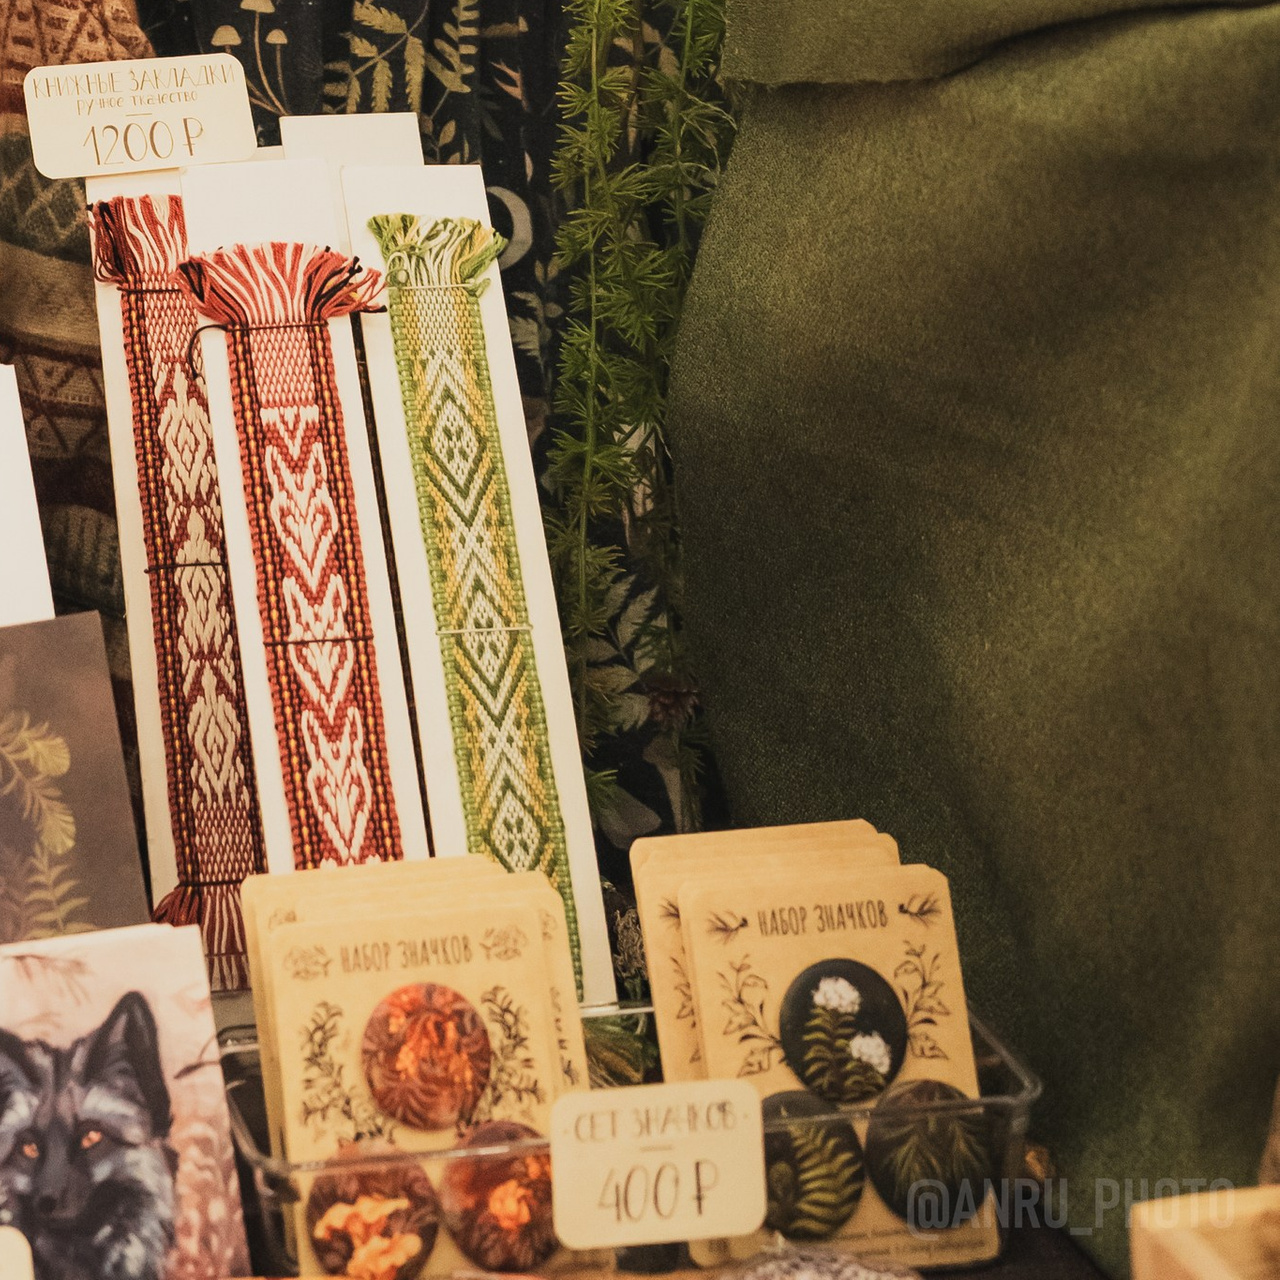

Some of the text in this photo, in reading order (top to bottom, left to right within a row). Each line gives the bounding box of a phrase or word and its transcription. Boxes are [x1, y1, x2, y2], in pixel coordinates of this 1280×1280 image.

[32, 64, 235, 98] КНИЖНЫЕ ЗАКЛАДКИ
[76, 91, 198, 116] ручное ткачество
[82, 120, 174, 165] 1200
[757, 899, 888, 937] НАБОР ЗНАЧКОВ
[340, 934, 473, 973] НАБОР ЗНАЧКОВ
[575, 1109, 618, 1143] СЕТ
[597, 1161, 679, 1223] 400
